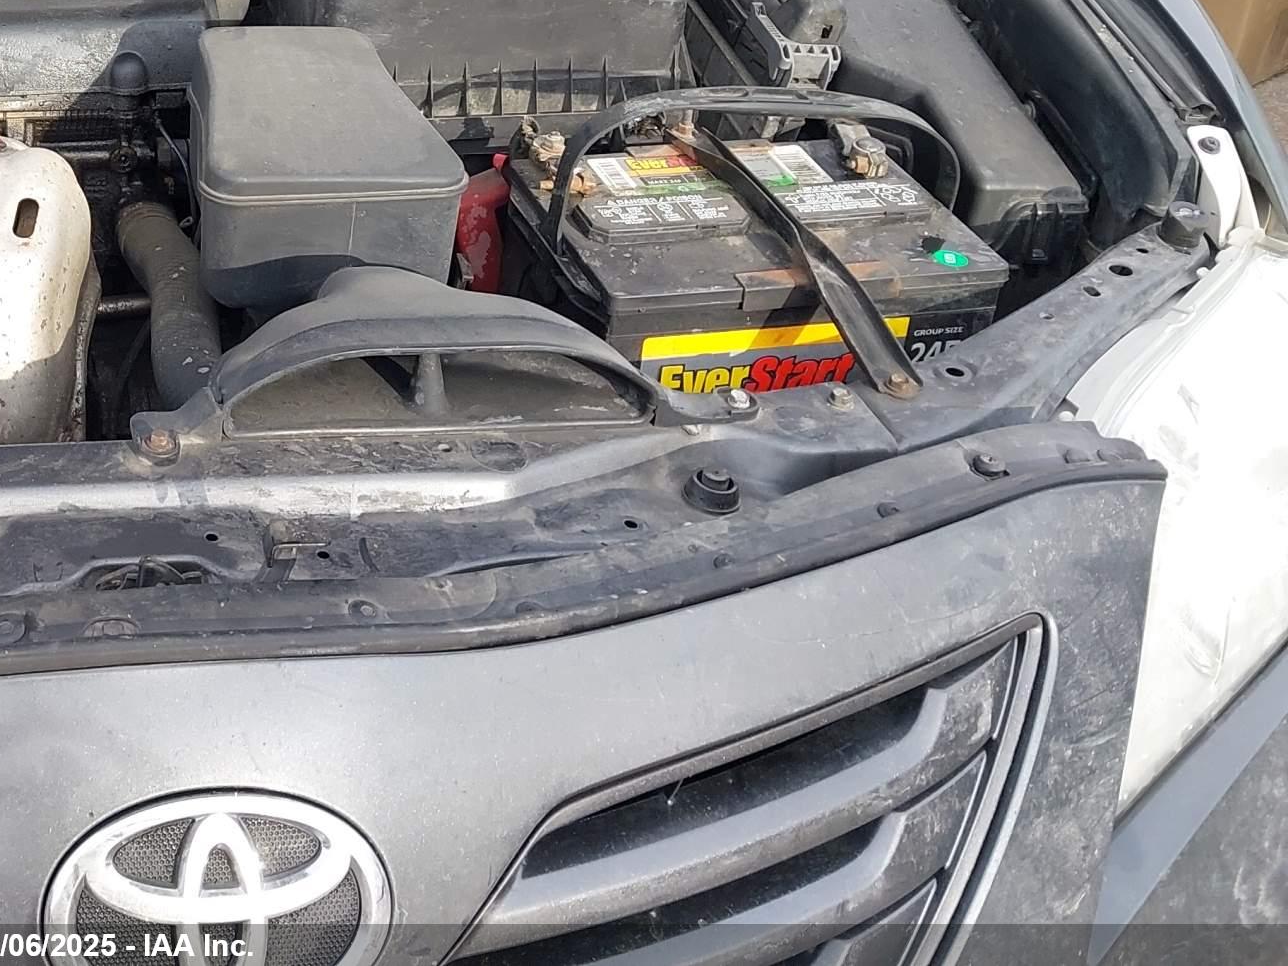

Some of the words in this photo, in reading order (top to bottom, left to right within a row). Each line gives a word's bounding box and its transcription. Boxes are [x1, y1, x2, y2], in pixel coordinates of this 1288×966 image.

[913, 328, 944, 337] GROUP
[944, 326, 965, 334] SIZE
[660, 352, 856, 394] EverStart
